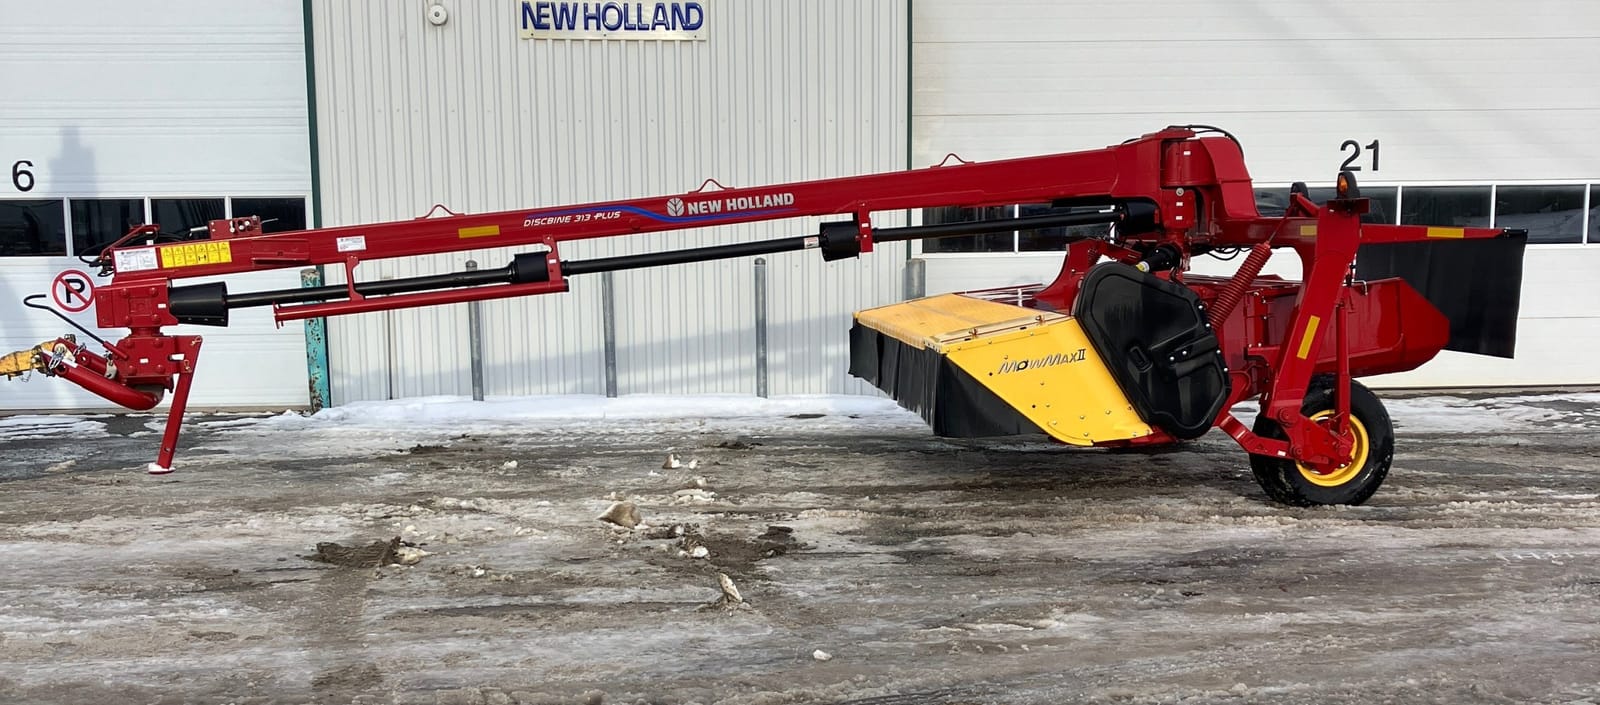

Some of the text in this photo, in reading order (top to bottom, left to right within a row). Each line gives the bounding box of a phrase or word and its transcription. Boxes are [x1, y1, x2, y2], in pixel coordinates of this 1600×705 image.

[522, 1, 704, 32] NEW HOLLAND
[1339, 139, 1379, 172] 21
[12, 160, 35, 192] 6
[687, 192, 794, 215] NEW HOLLAND
[523, 211, 621, 227] DISCBINE 313 PLUS
[65, 278, 86, 304] P
